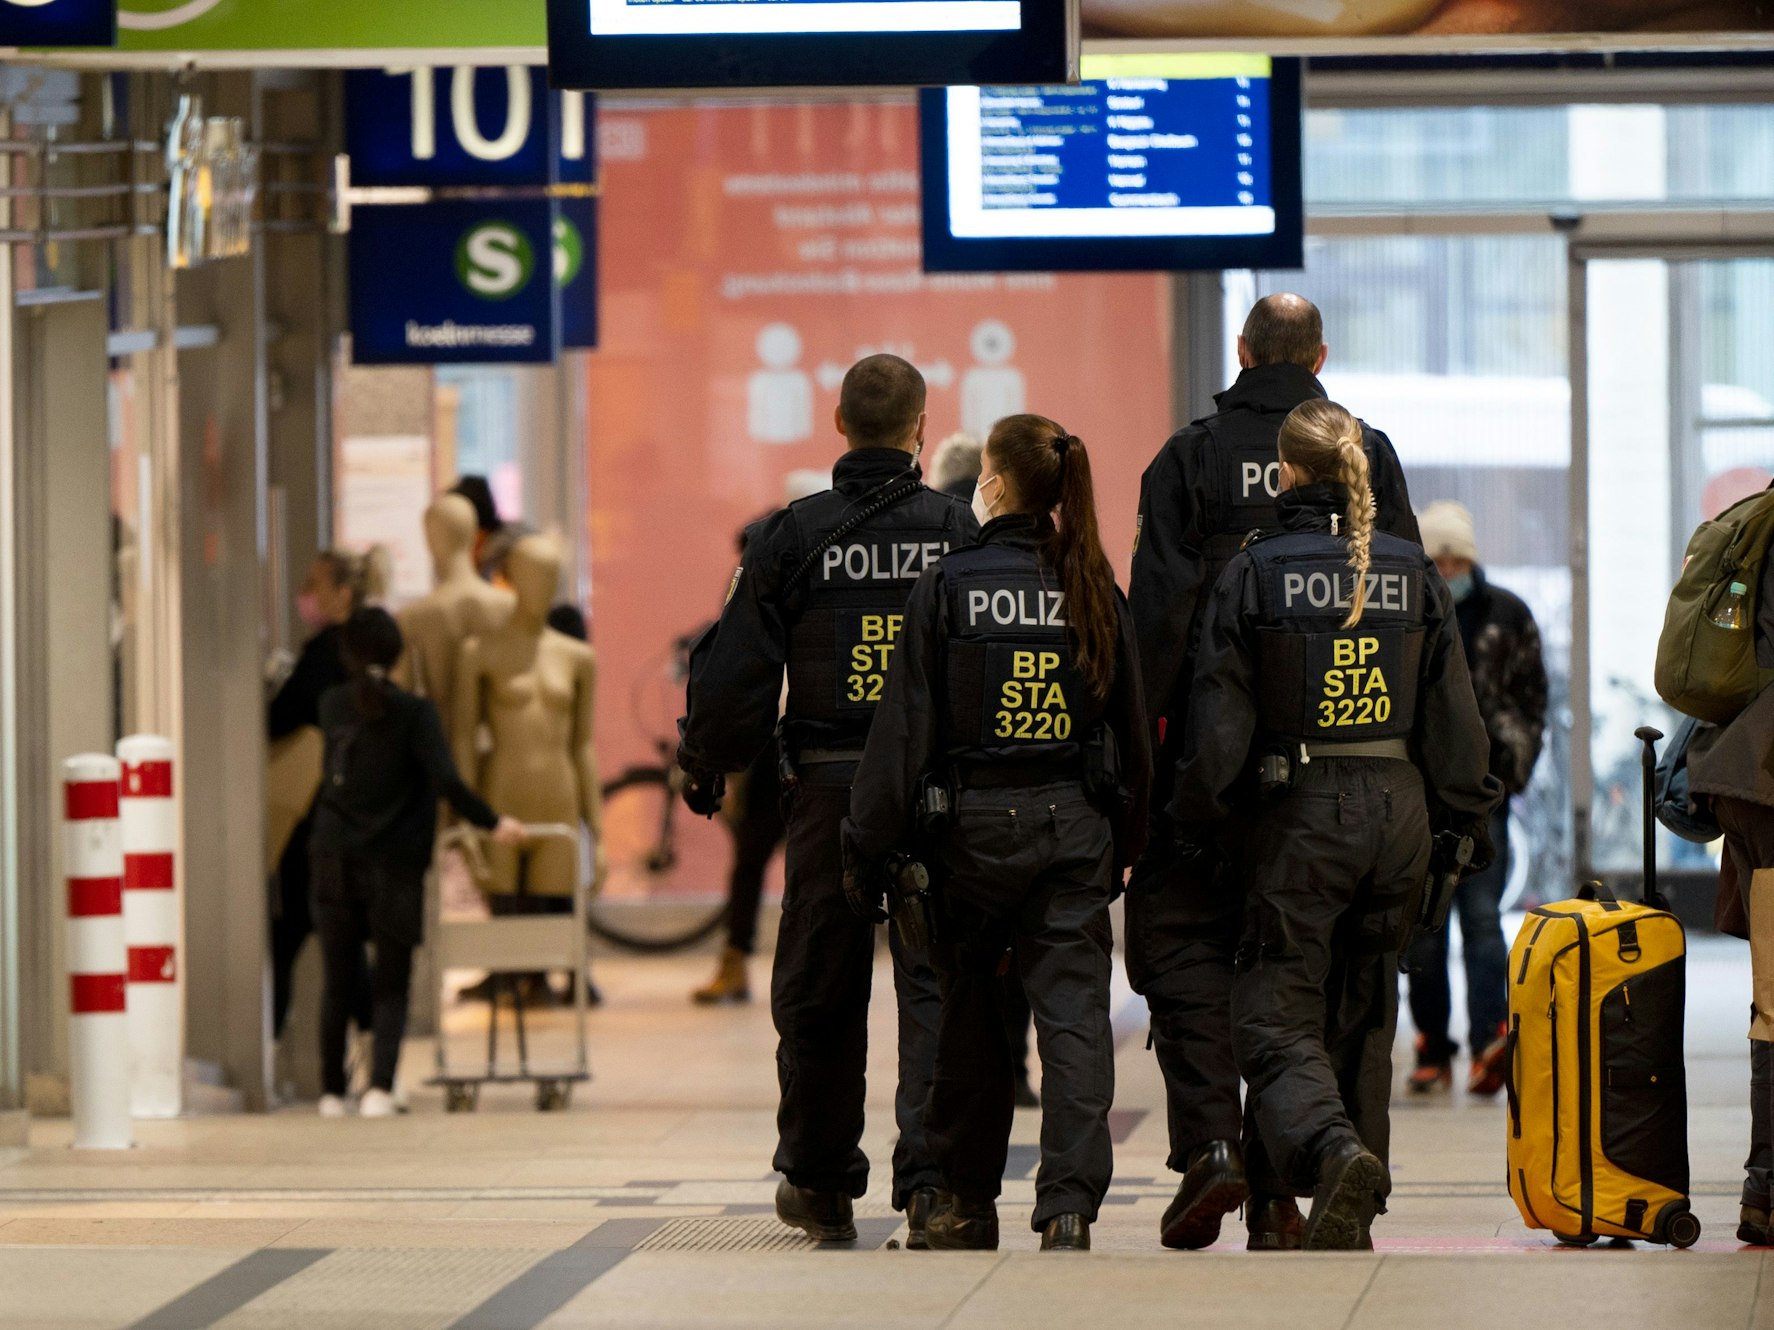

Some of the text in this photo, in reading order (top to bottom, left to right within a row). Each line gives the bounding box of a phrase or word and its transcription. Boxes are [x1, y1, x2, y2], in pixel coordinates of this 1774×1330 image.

[465, 225, 522, 294] S
[851, 644, 895, 672] ST
[1013, 651, 1060, 679] BP
[1333, 637, 1380, 667] BP
[847, 674, 884, 702] 32
[1000, 681, 1068, 710] STA
[1323, 667, 1388, 697] STA
[994, 711, 1072, 740] 3220
[1317, 695, 1391, 727] 3220
